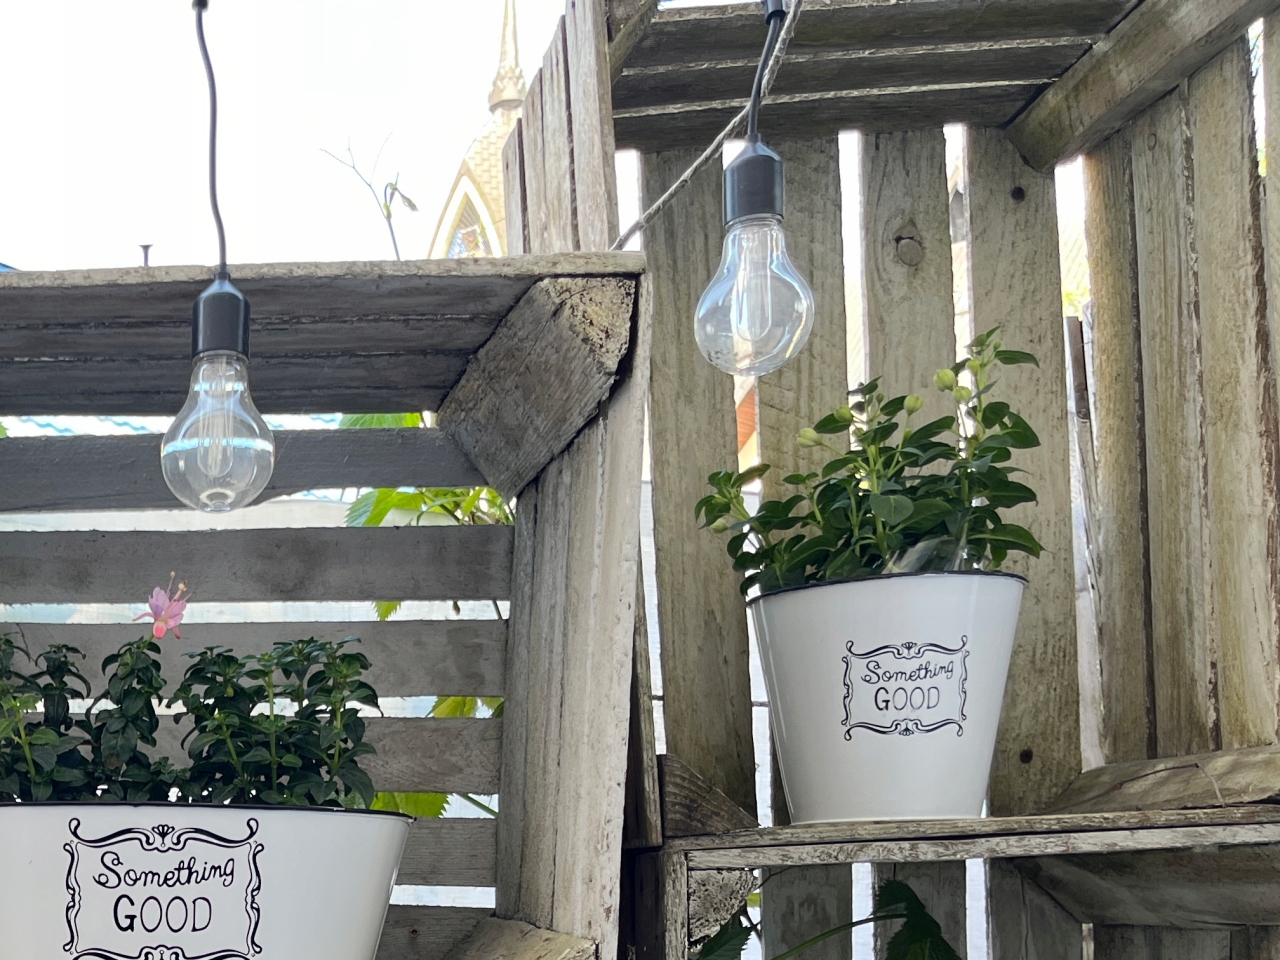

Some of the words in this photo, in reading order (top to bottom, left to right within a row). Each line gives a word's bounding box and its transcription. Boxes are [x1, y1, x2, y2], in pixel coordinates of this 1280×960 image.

[860, 660, 954, 684] Something
[874, 686, 940, 711] GOOD
[92, 850, 235, 889] Something
[113, 894, 212, 933] GOOD
